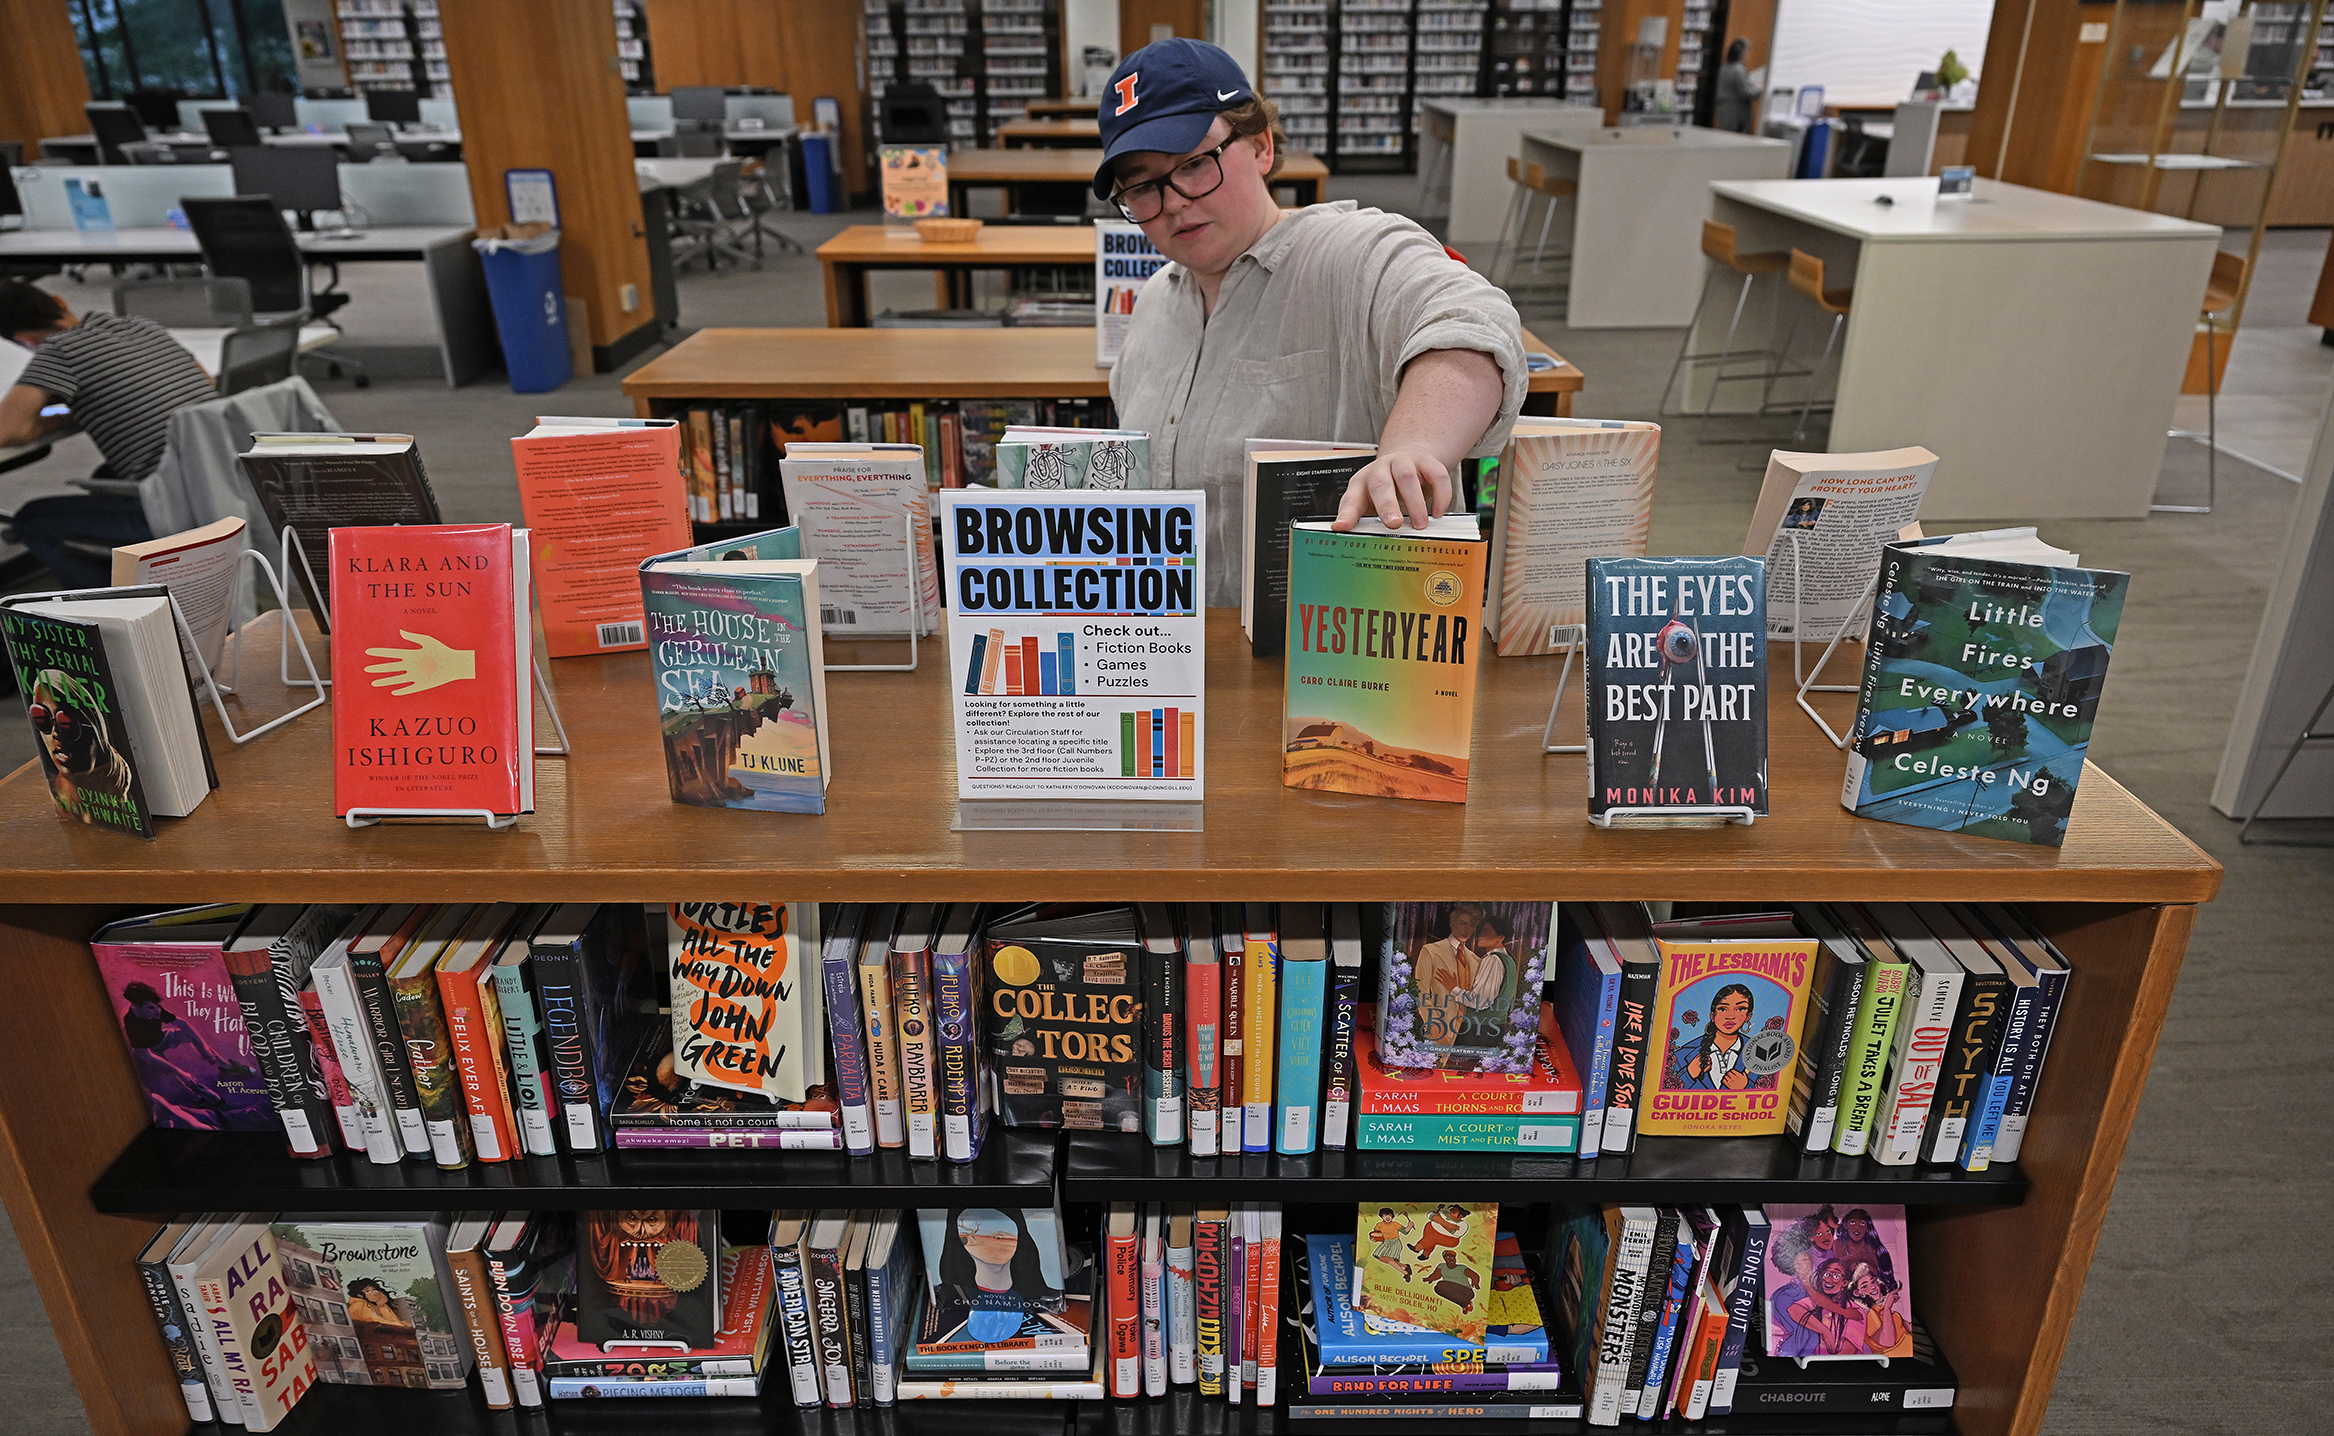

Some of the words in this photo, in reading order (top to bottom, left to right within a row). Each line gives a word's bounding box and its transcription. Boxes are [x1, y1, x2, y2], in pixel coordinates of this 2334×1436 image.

[1104, 234, 1161, 254] BROW
[857, 473, 911, 482] EVERYTHING
[1810, 486, 1855, 494] PROTECT
[1858, 485, 1883, 494] YOUR
[1884, 482, 1918, 492] HEART?
[1847, 478, 1874, 486] LONG
[1876, 477, 1895, 485] CAN
[1898, 474, 1916, 482] YOU
[956, 507, 1192, 556] BROWSING
[350, 556, 428, 573] KLARA
[440, 554, 489, 570] AND
[368, 582, 416, 598] THE
[426, 582, 472, 597] SUN
[960, 568, 1191, 610] COLLECTION
[1606, 576, 1668, 616] THE
[1677, 575, 1754, 616] EYES
[2, 614, 25, 637] MY
[651, 612, 686, 634] THE
[691, 610, 770, 644] HOUSE
[777, 623, 786, 633] IN
[1968, 602, 2044, 628] Little
[775, 634, 791, 644] THE
[1082, 625, 1131, 636] Check
[1134, 625, 1171, 636] out...
[1300, 604, 1468, 665] YESTERYEAR
[10, 640, 40, 663] THE
[45, 648, 100, 676] SERIAL
[659, 640, 782, 674] CERULEAN
[1096, 642, 1145, 654] Fiction
[1148, 642, 1191, 654] Books
[1606, 633, 1660, 669] ARE
[1700, 632, 1755, 668] THE
[1962, 643, 2032, 670] Fires
[1096, 659, 1146, 671] Games
[16, 665, 110, 714] KILLER
[661, 670, 732, 712] SEA
[1097, 676, 1149, 688] Puzzles
[1301, 676, 1324, 686] CARO
[1327, 678, 1358, 689] CLAIRE
[1362, 680, 1390, 692] BURKE
[964, 700, 996, 709] Looking
[999, 700, 1010, 708] for
[1013, 700, 1056, 710] something
[1065, 700, 1085, 708] little
[1606, 685, 1676, 721] BEST
[1683, 685, 1756, 721] PART
[1900, 678, 2078, 718] Everywhere
[370, 716, 476, 738] KAZUO
[965, 710, 1006, 718] different?
[1008, 710, 1039, 718] Explore
[1041, 710, 1055, 718] the
[1075, 710, 1084, 718] of
[348, 746, 498, 767] ISHIGURO
[742, 754, 756, 769] TJ
[762, 756, 805, 774] KLUNE
[1894, 753, 1995, 784] Celeste
[2008, 768, 2050, 796] Ng
[78, 787, 138, 814] OYINKAN
[1606, 788, 1697, 804] MONIKA
[1713, 788, 1755, 804] KIM
[56, 796, 142, 831] BRAITHWAITE
[534, 954, 568, 962] DEONN
[682, 926, 725, 956] ALL
[728, 940, 777, 968] THE
[672, 957, 720, 985] WAY
[718, 965, 793, 1002] DOWN
[1669, 953, 1706, 988] THE
[1706, 952, 1808, 988] LESBIANA'S
[160, 971, 195, 998] This
[1852, 971, 1864, 1004] JASON
[184, 1000, 210, 1020] They
[362, 986, 388, 1039] WARRIOR
[992, 988, 1134, 1024] COLLEC
[1404, 988, 1520, 1014] SELF-MADE
[1930, 979, 1950, 1022] SCHRIEVE
[690, 990, 771, 1042] JOHN
[1420, 1008, 1501, 1041] BOYS
[1871, 996, 1895, 1037] JULIET
[1335, 1003, 1352, 1058] SCATTER
[1838, 1006, 1858, 1059] REYNOLDS
[452, 1016, 471, 1052] FELIX
[462, 1054, 479, 1091] EVER
[681, 1034, 786, 1078] GREEN
[1036, 1030, 1133, 1063] TORS
[1861, 1039, 1886, 1079] TAKES
[406, 1039, 436, 1089] Gather
[838, 1034, 861, 1101] PARDALITA
[906, 1042, 928, 1114] RAYBEARER
[518, 1072, 539, 1110] LION
[1858, 1081, 1872, 1092] A
[1652, 1094, 1736, 1110] GUIDE
[1746, 1093, 1779, 1110] TO
[1652, 1112, 1720, 1120] CATHOLIC
[1722, 1111, 1776, 1120] SCHOOL
[1849, 1092, 1872, 1132] BREATH
[670, 1117, 700, 1127] home
[704, 1117, 712, 1127] is
[714, 1118, 734, 1127] not
[1368, 1123, 1412, 1132] SARAH
[1445, 1124, 1454, 1132] A
[1460, 1124, 1502, 1132] COURT
[708, 1132, 765, 1148] PET
[1365, 1135, 1373, 1144] J.
[1376, 1134, 1414, 1144] MAAS
[1438, 1134, 1468, 1144] MIST
[1487, 1135, 1519, 1145] FURY
[320, 1242, 419, 1264] Brownstone
[1117, 1246, 1126, 1276] Police
[1742, 1238, 1765, 1286] STONE
[455, 1268, 477, 1310] SAINTS
[1127, 1262, 1138, 1302] Memory
[1374, 1284, 1393, 1294] BLUE
[1395, 1286, 1444, 1306] DELLIQUANTI
[780, 1270, 808, 1338] AMERICAN
[954, 1298, 980, 1306] CHO
[986, 1299, 1042, 1309] NAM-JOO
[1600, 1268, 1636, 1366] MONSTERS
[1730, 1288, 1754, 1333] FRUIT
[180, 1288, 213, 1365] sadie
[622, 1330, 630, 1338] A.
[632, 1330, 639, 1338] R.
[640, 1329, 664, 1339] VISHNY
[1118, 1324, 1128, 1354] Ogawa
[1129, 1320, 1138, 1343] Yoko
[936, 1344, 958, 1352] BOOK
[959, 1342, 996, 1350] CENSOR'S
[997, 1340, 1030, 1348] LIBRARY
[1332, 1354, 1377, 1363] ALISON
[1380, 1354, 1430, 1363] BECHDEL
[1333, 1380, 1375, 1392] BAND
[1378, 1380, 1409, 1392] FOR
[1413, 1379, 1454, 1392] LIFE
[1759, 1391, 1826, 1402] CHABOUTÉ
[1870, 1392, 1891, 1402] ALONE
